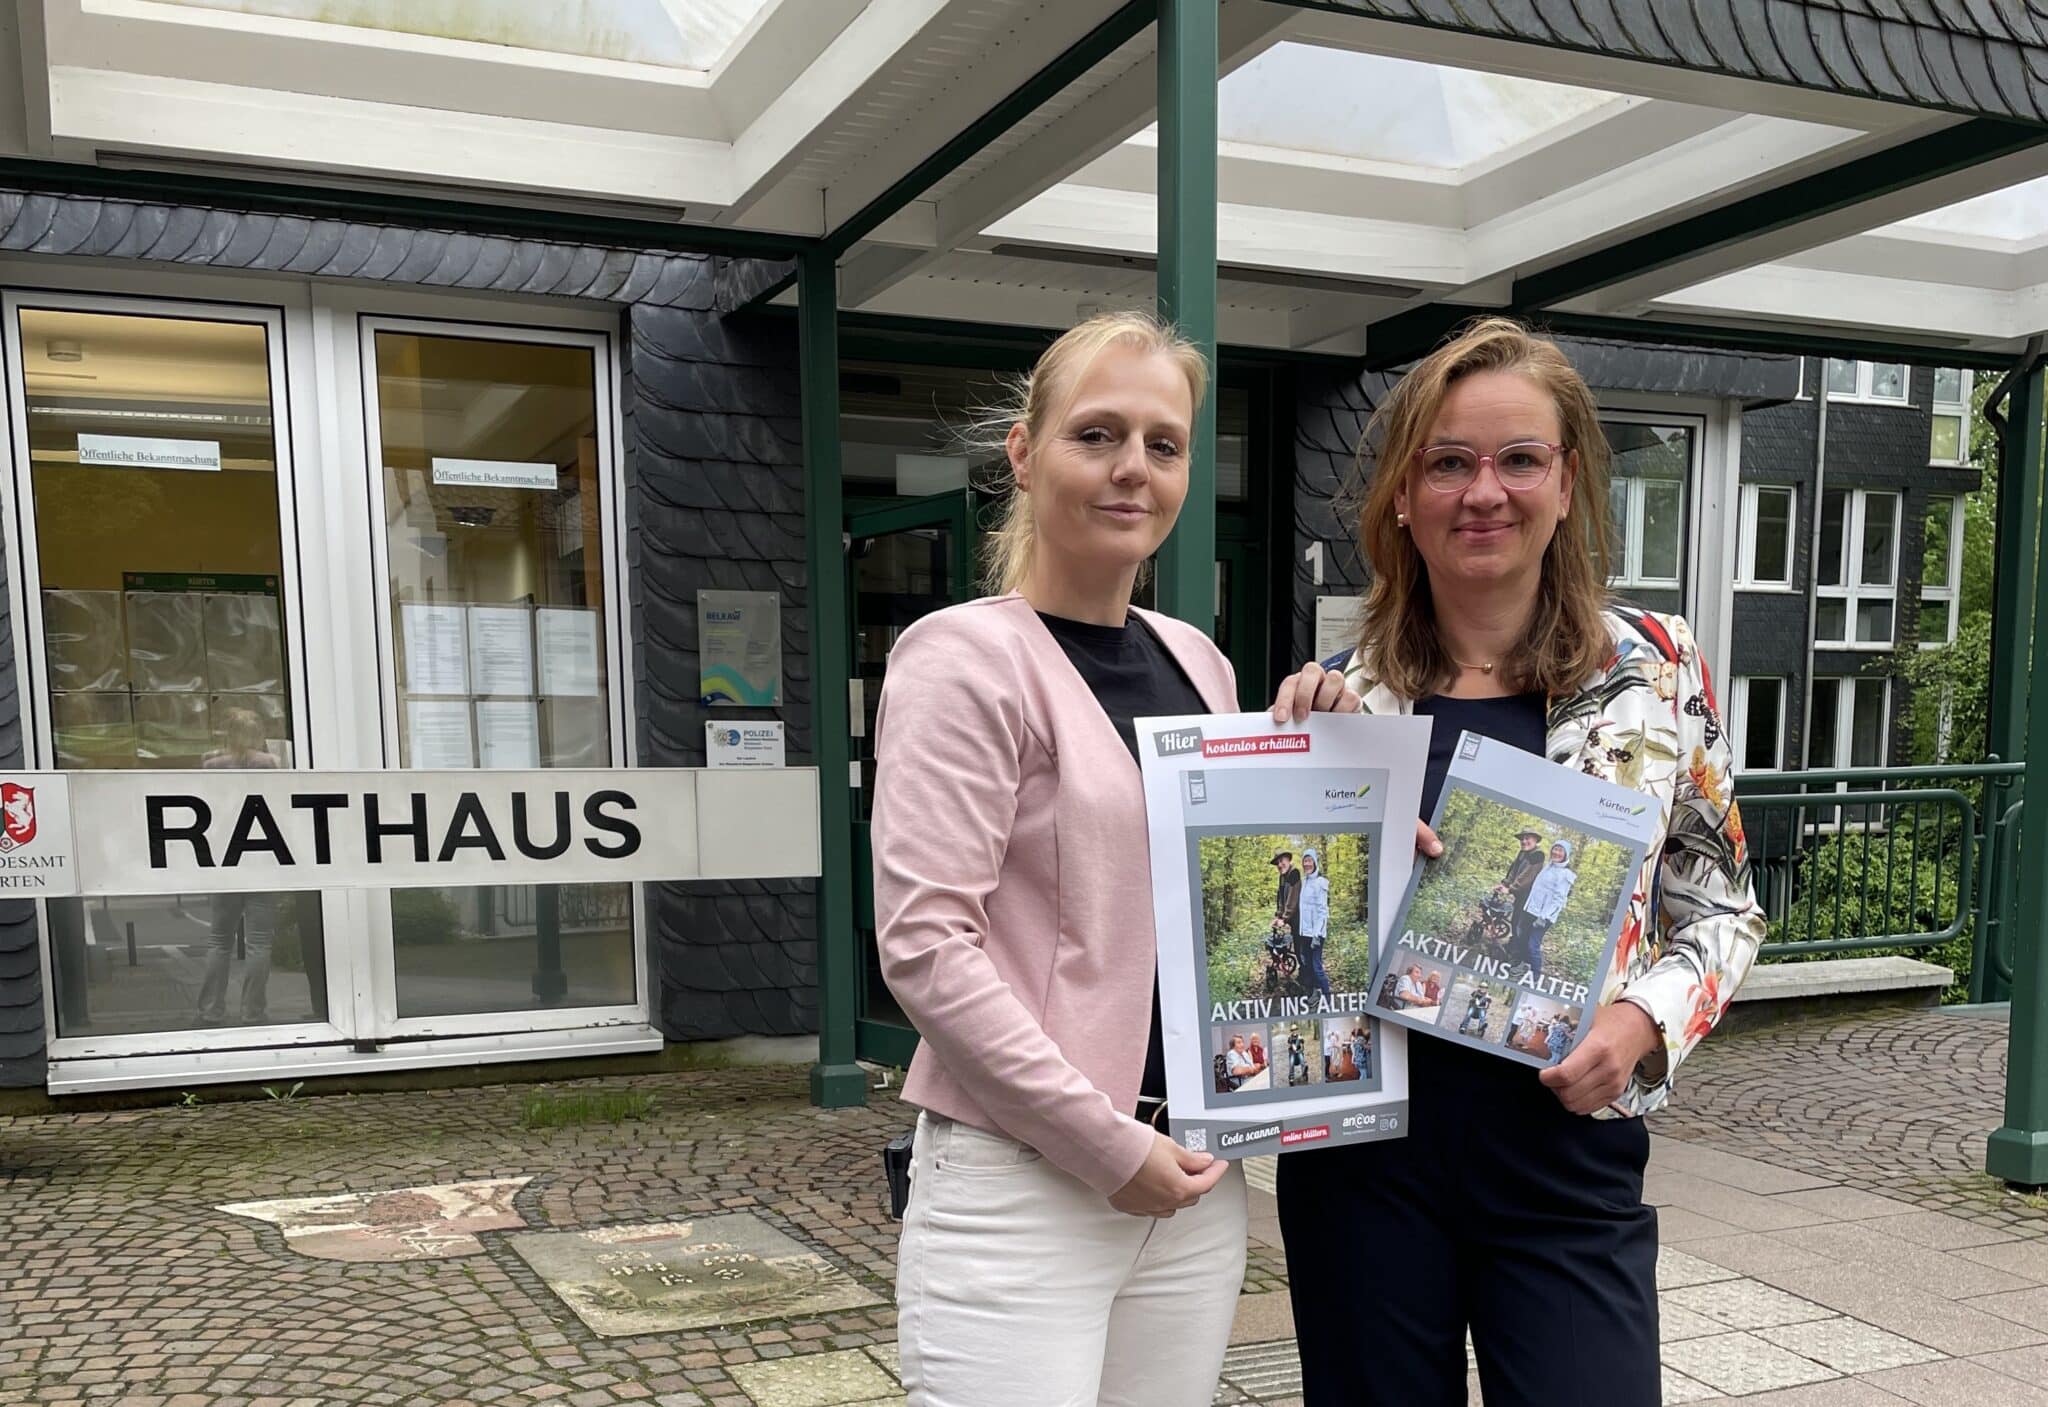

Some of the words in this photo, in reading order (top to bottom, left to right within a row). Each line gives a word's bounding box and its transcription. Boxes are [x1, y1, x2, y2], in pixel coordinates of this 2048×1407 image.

[80, 447, 133, 461] Öffentliche
[137, 451, 218, 466] Bekanntmachung
[434, 470, 480, 482] Öffentliche
[484, 472, 555, 487] Bekanntmachung
[1305, 541, 1323, 585] 1
[1161, 733, 1197, 751] Hier
[1206, 739, 1257, 755] kostenlos
[1259, 736, 1307, 751] erhältlich
[1325, 786, 1356, 799] Kürten
[1599, 797, 1631, 815] Kürten
[145, 790, 642, 868] RATHAUS
[1398, 930, 1468, 965] AKTIV
[1474, 954, 1512, 980] INS
[1518, 970, 1590, 1003] ALTER
[1211, 998, 1273, 1022] AKTIV
[1280, 996, 1309, 1017] INS
[1221, 1132, 1245, 1147] Code
[1245, 1125, 1281, 1143] scannen
[1283, 1132, 1302, 1143] online
[1303, 1127, 1328, 1140] blättern
